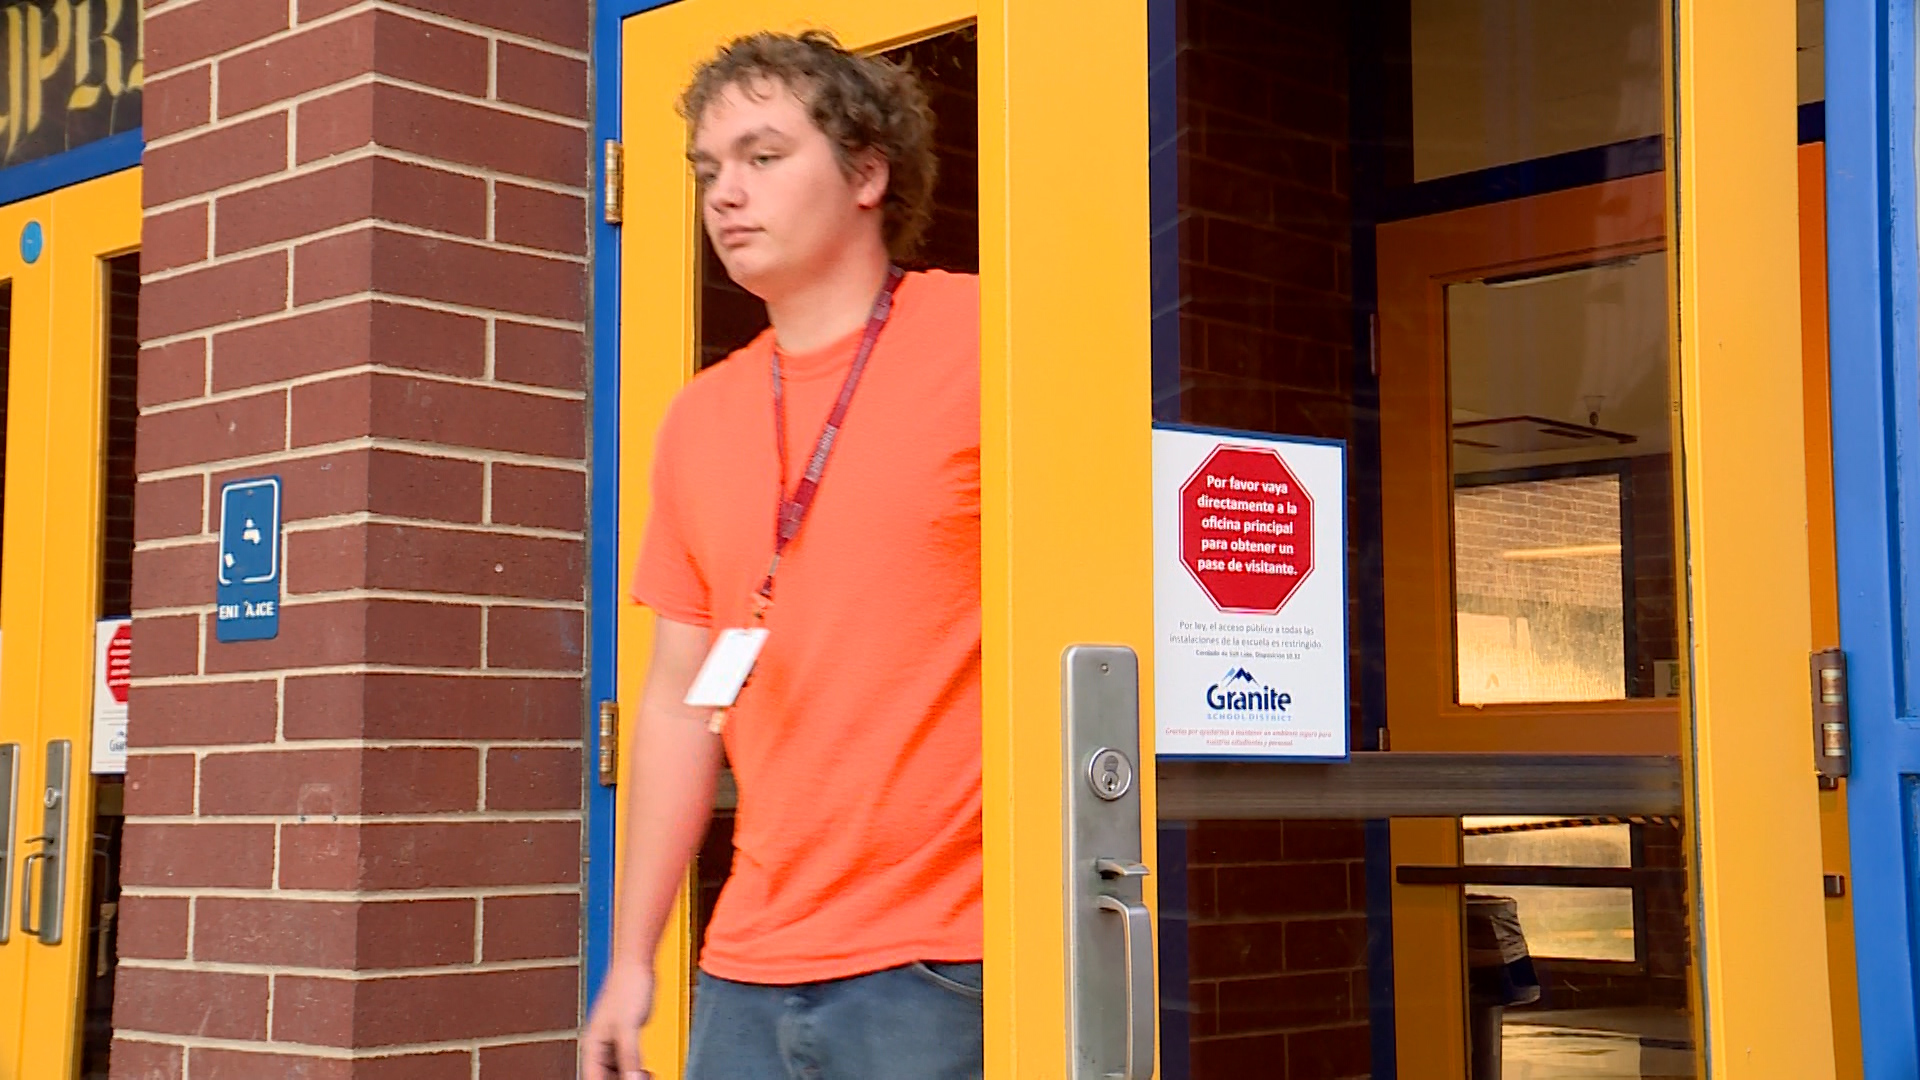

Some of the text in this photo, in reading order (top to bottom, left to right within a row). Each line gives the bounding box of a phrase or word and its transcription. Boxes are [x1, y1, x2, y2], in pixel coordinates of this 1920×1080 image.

[1206, 475, 1288, 496] Por favor vaya
[1197, 494, 1298, 515] directamente a la
[1201, 515, 1294, 536] oficina principal
[1201, 538, 1294, 555] para obtener un
[1197, 558, 1298, 576] pase de visitante.
[1179, 620, 1193, 630] Por
[1194, 621, 1208, 631] ley,
[1209, 621, 1217, 630] el
[1218, 623, 1245, 632] acceso
[1246, 623, 1274, 634] público
[1281, 625, 1303, 635] todas
[1303, 626, 1314, 636] las
[1169, 634, 1220, 644] instalaciones
[1221, 636, 1231, 645] de
[1232, 636, 1240, 645] la
[1241, 638, 1270, 647] escuela
[1271, 640, 1280, 648] es
[1206, 683, 1292, 712] Granite
[1206, 713, 1293, 722] SCHOOL DISTRICT
